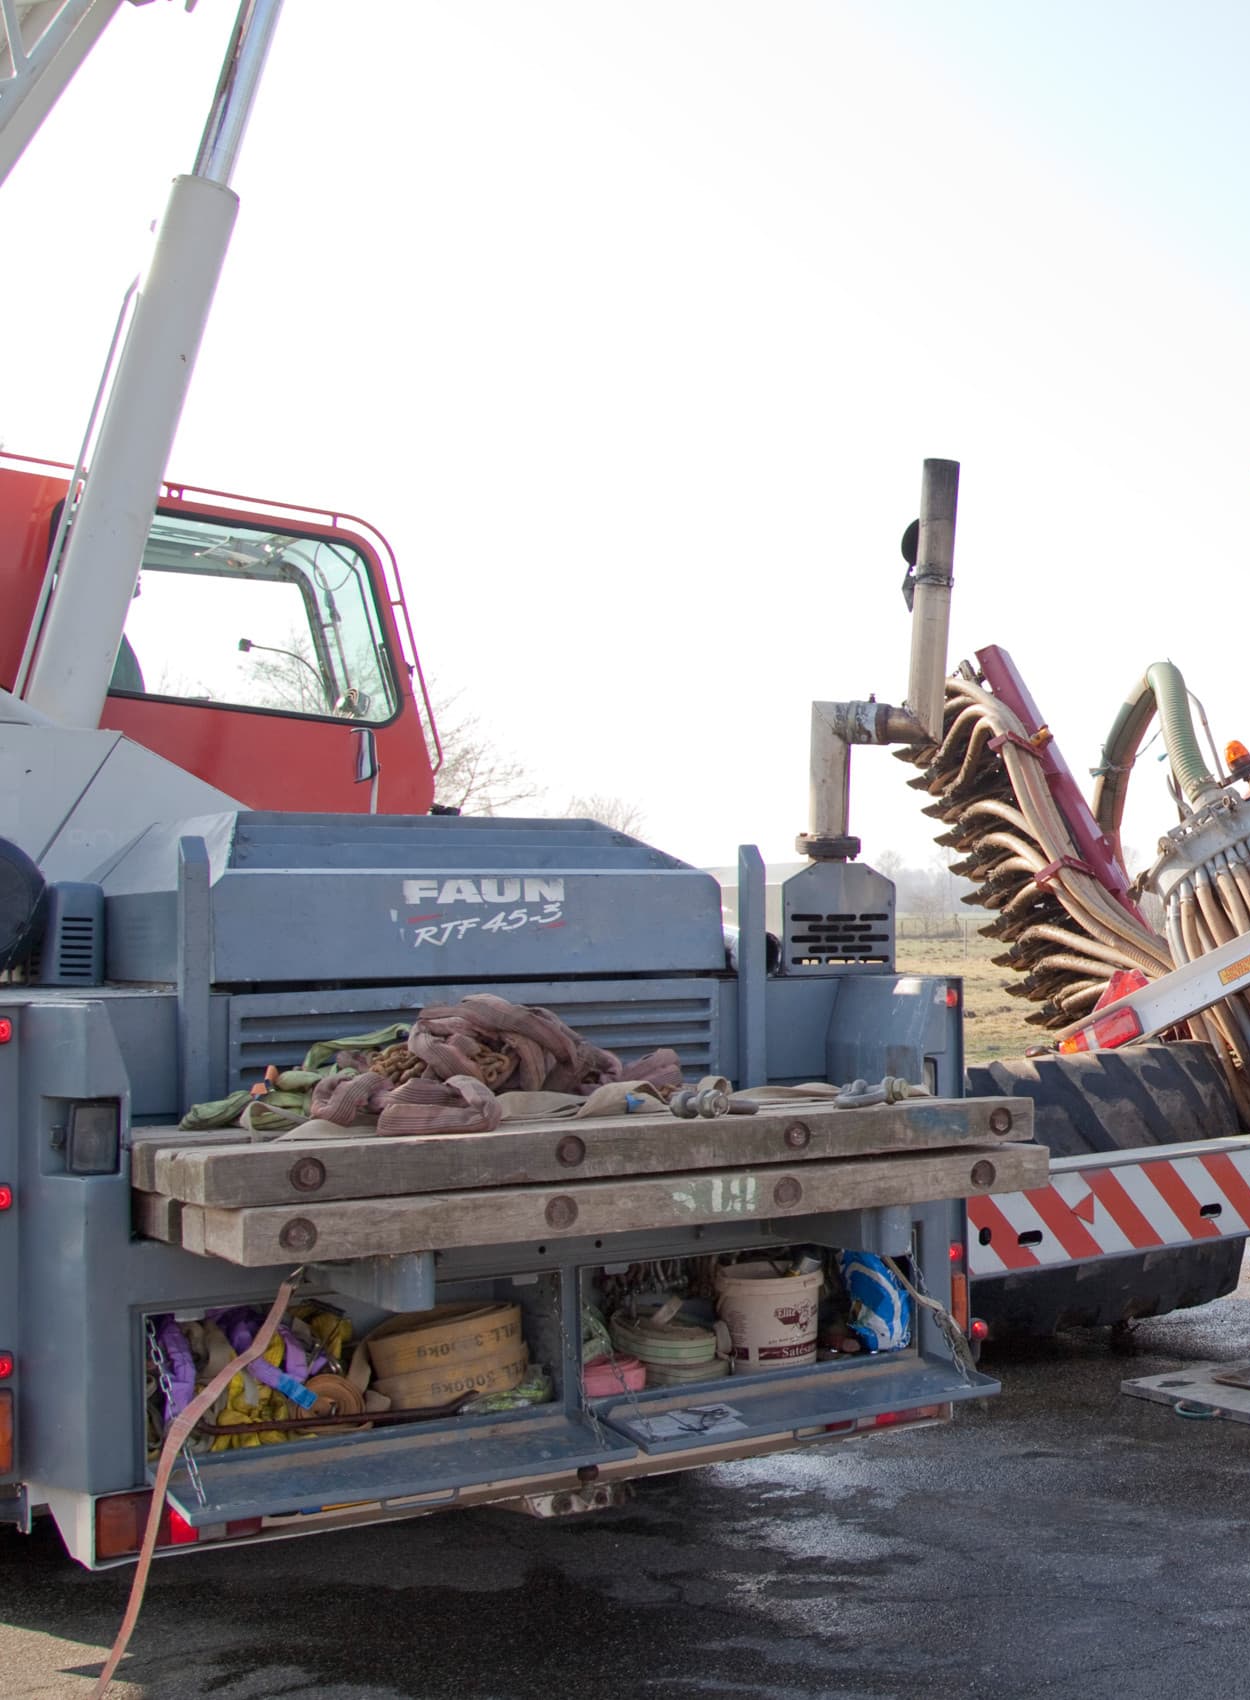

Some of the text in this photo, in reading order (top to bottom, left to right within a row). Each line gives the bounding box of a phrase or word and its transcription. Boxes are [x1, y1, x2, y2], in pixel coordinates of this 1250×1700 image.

[403, 878, 565, 904] FAUN
[414, 902, 563, 947] RTF 45-3
